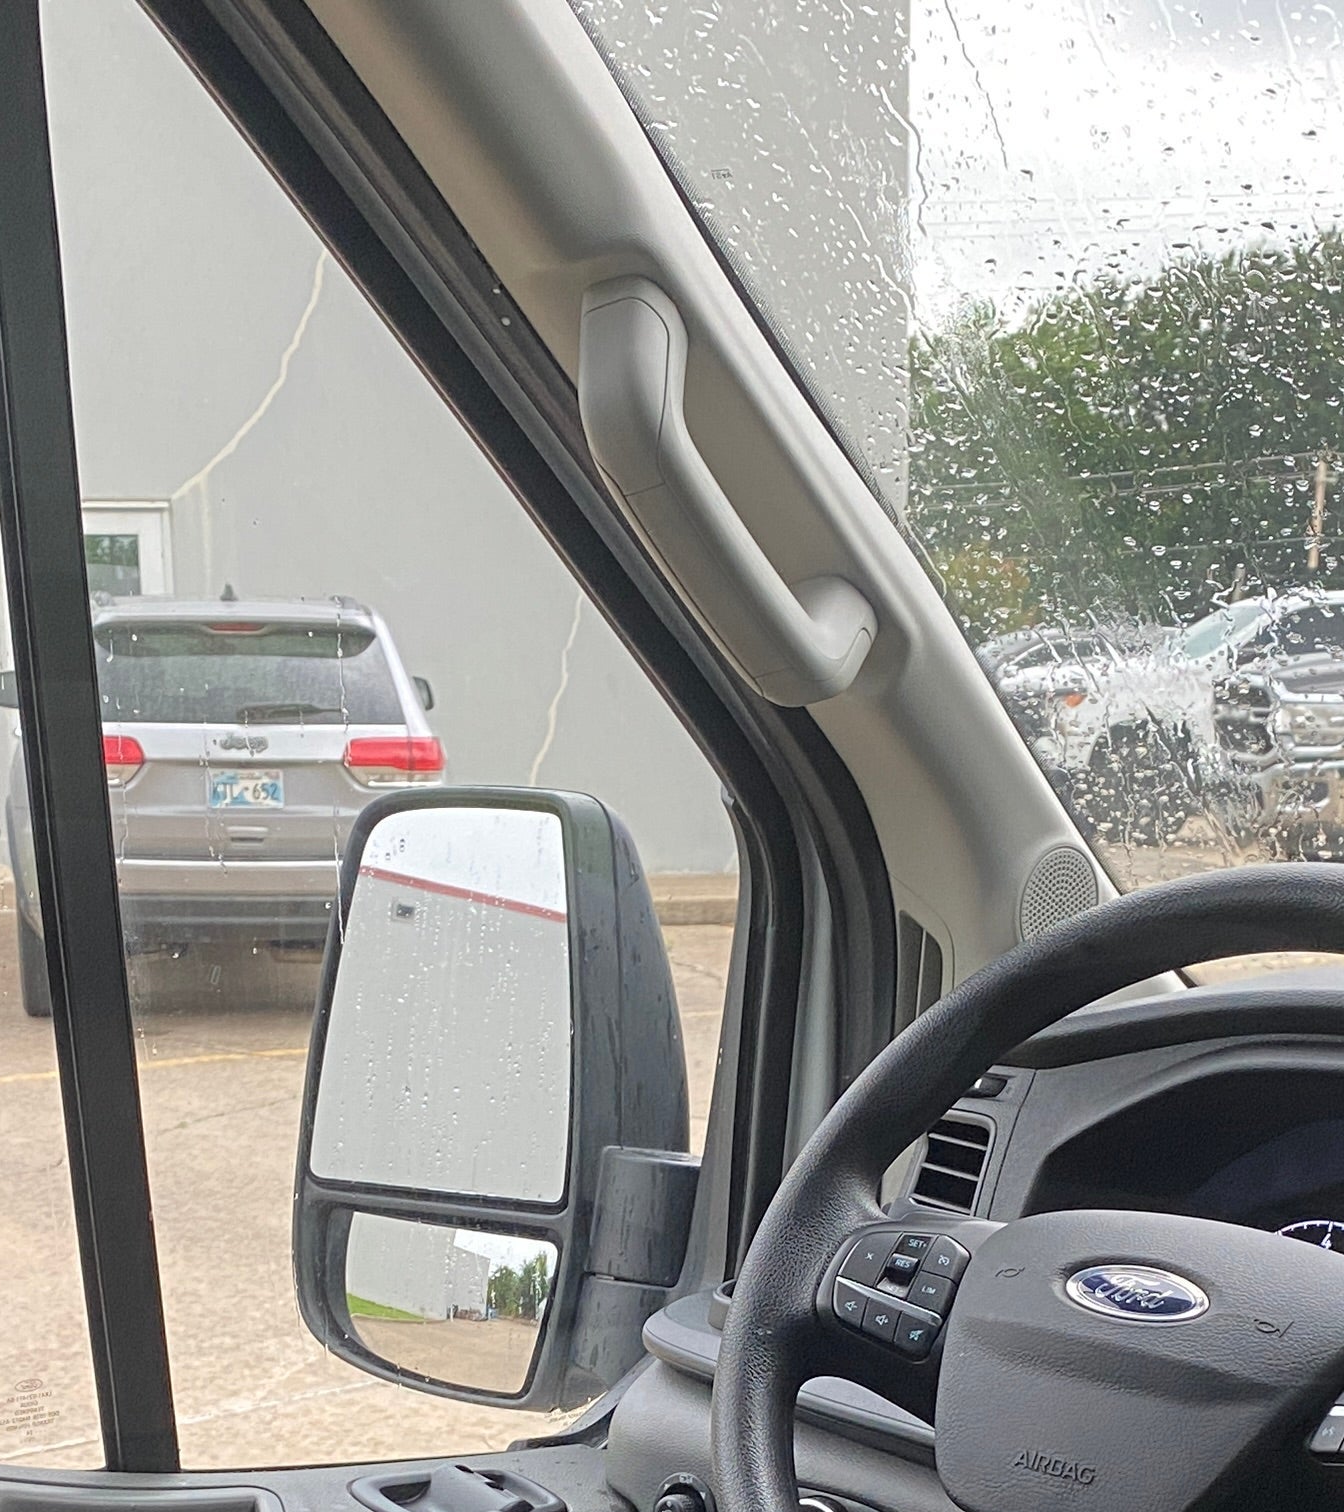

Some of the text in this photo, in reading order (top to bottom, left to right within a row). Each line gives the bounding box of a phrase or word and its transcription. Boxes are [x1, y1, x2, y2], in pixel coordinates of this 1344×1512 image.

[1321, 1234, 1333, 1250] 4
[1093, 1273, 1175, 1310] Ford
[1014, 1449, 1097, 1485] AIRBAG
